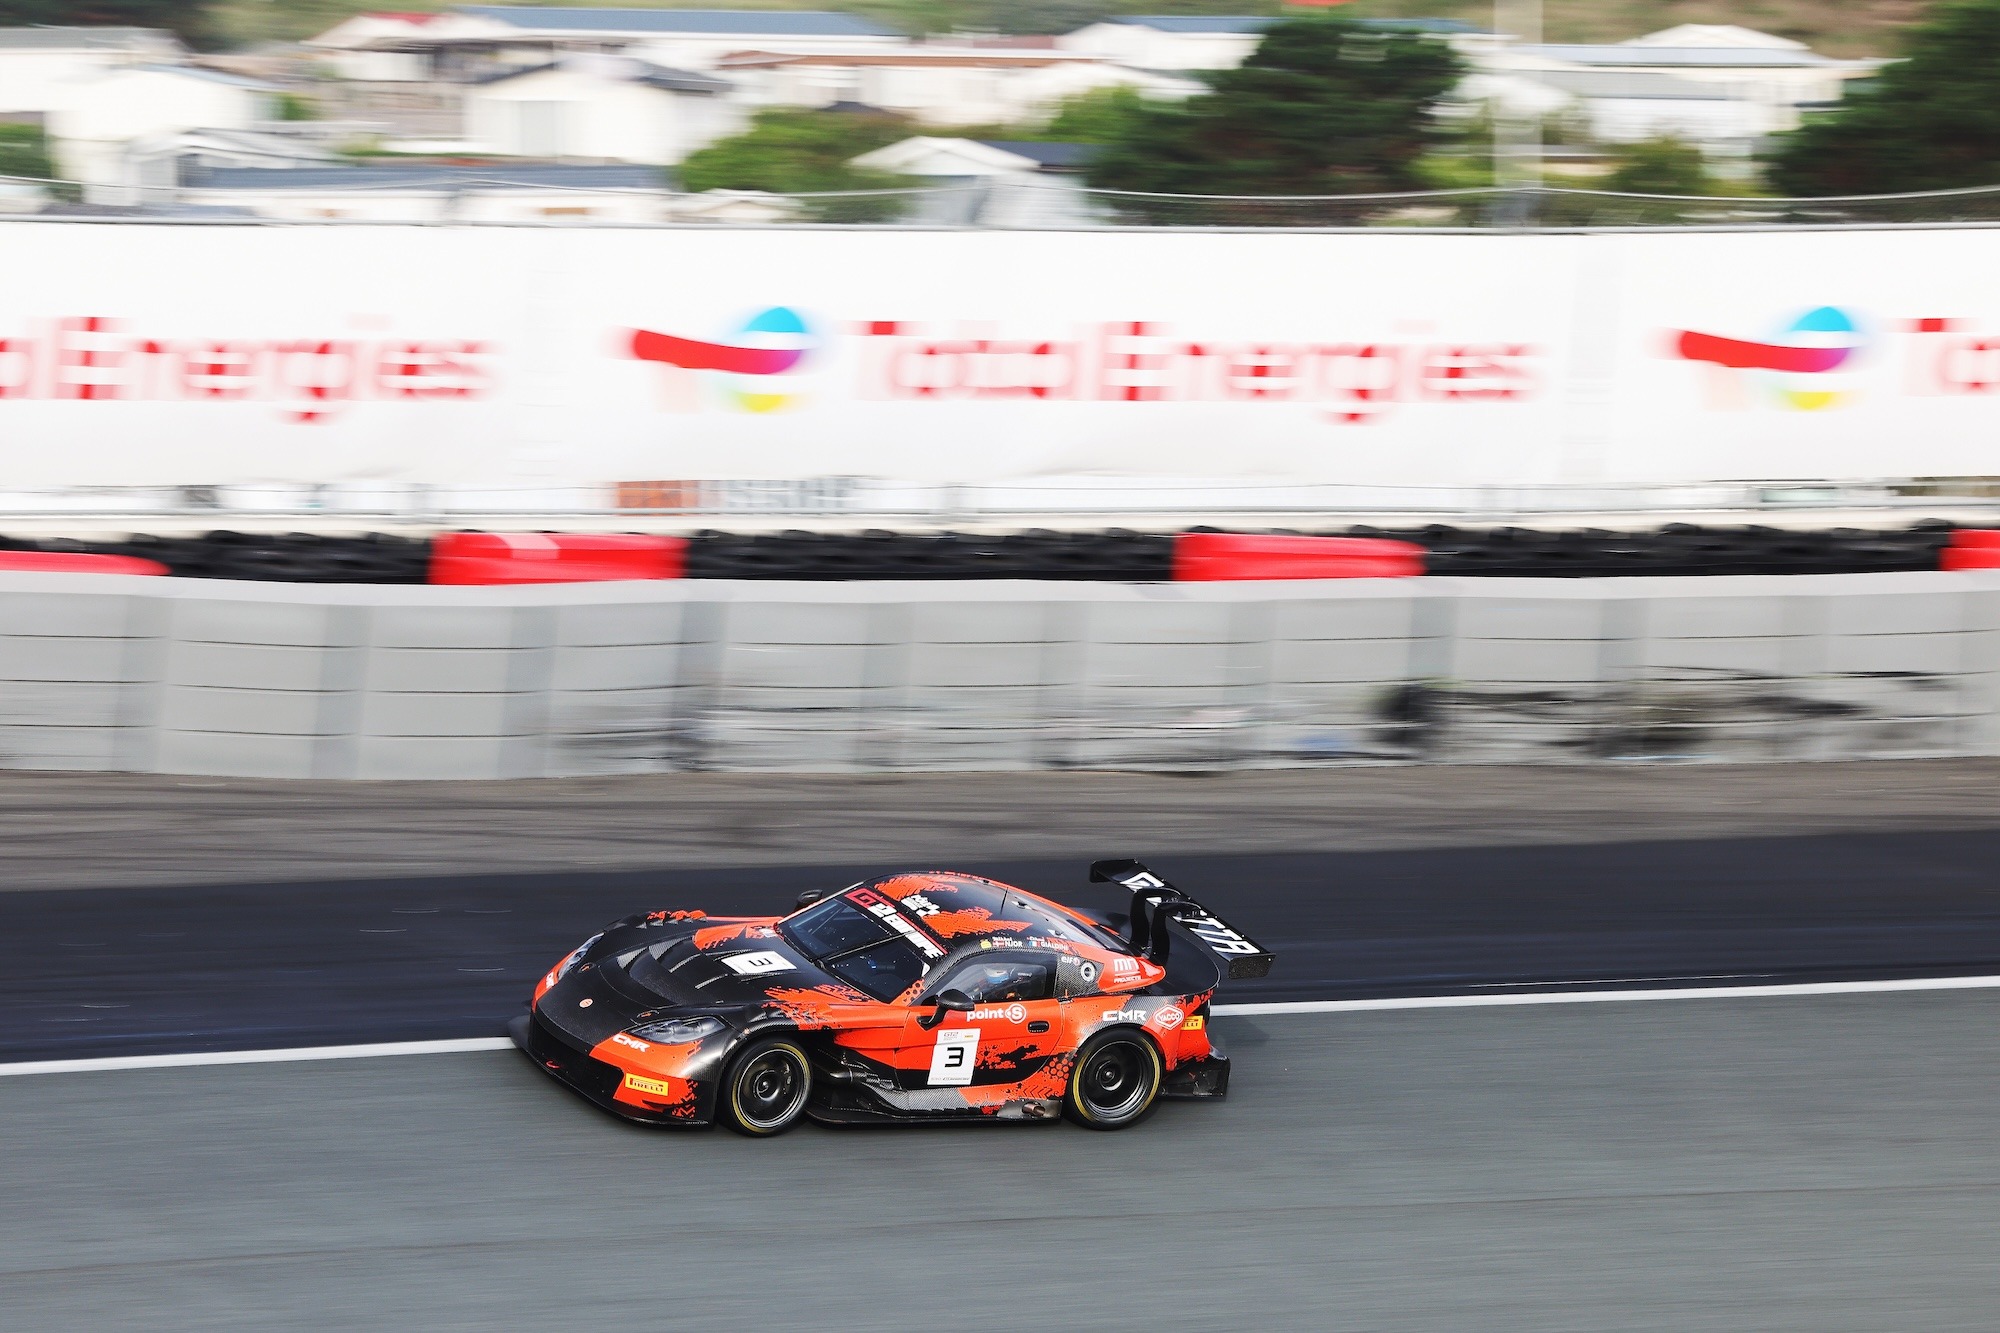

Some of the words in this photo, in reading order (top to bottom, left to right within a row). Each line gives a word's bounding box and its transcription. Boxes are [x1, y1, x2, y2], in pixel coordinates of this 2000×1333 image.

[848, 320, 1542, 427] TotalEnergies
[966, 1008, 1004, 1022] point
[1102, 1009, 1147, 1022] CMR
[1159, 1012, 1180, 1022] YACCO
[612, 1033, 651, 1053] CMR
[944, 1046, 965, 1068] 3
